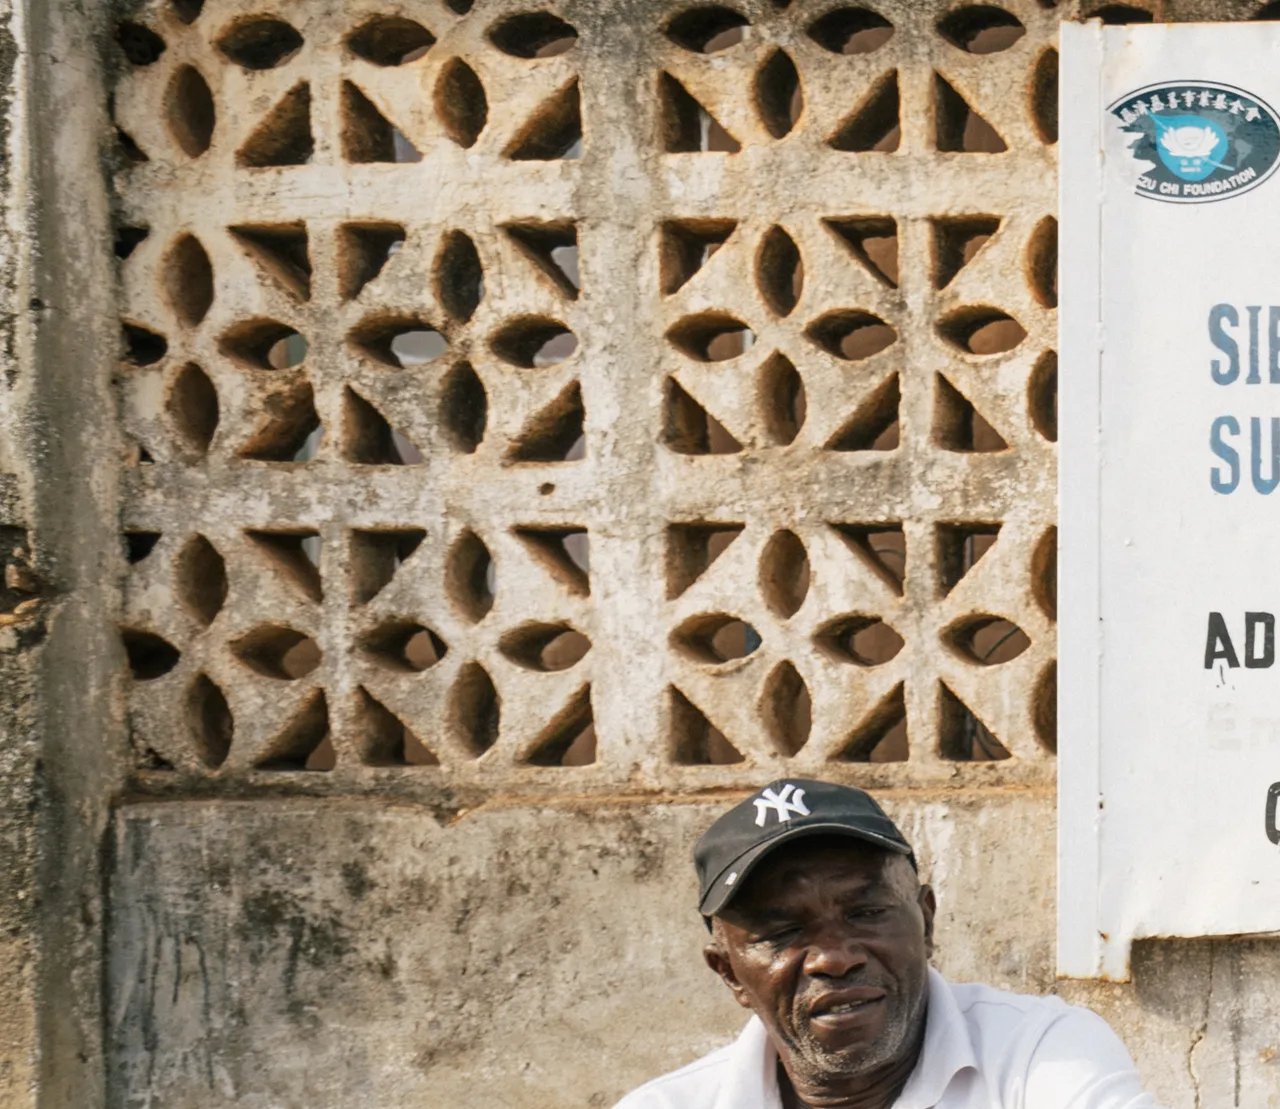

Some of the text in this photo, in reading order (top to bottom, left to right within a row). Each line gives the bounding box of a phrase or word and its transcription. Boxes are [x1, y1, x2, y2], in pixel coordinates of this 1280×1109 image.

[1159, 181, 1180, 195] CHI
[1183, 167, 1257, 196] FOUNDATION
[753, 784, 811, 827] NY
